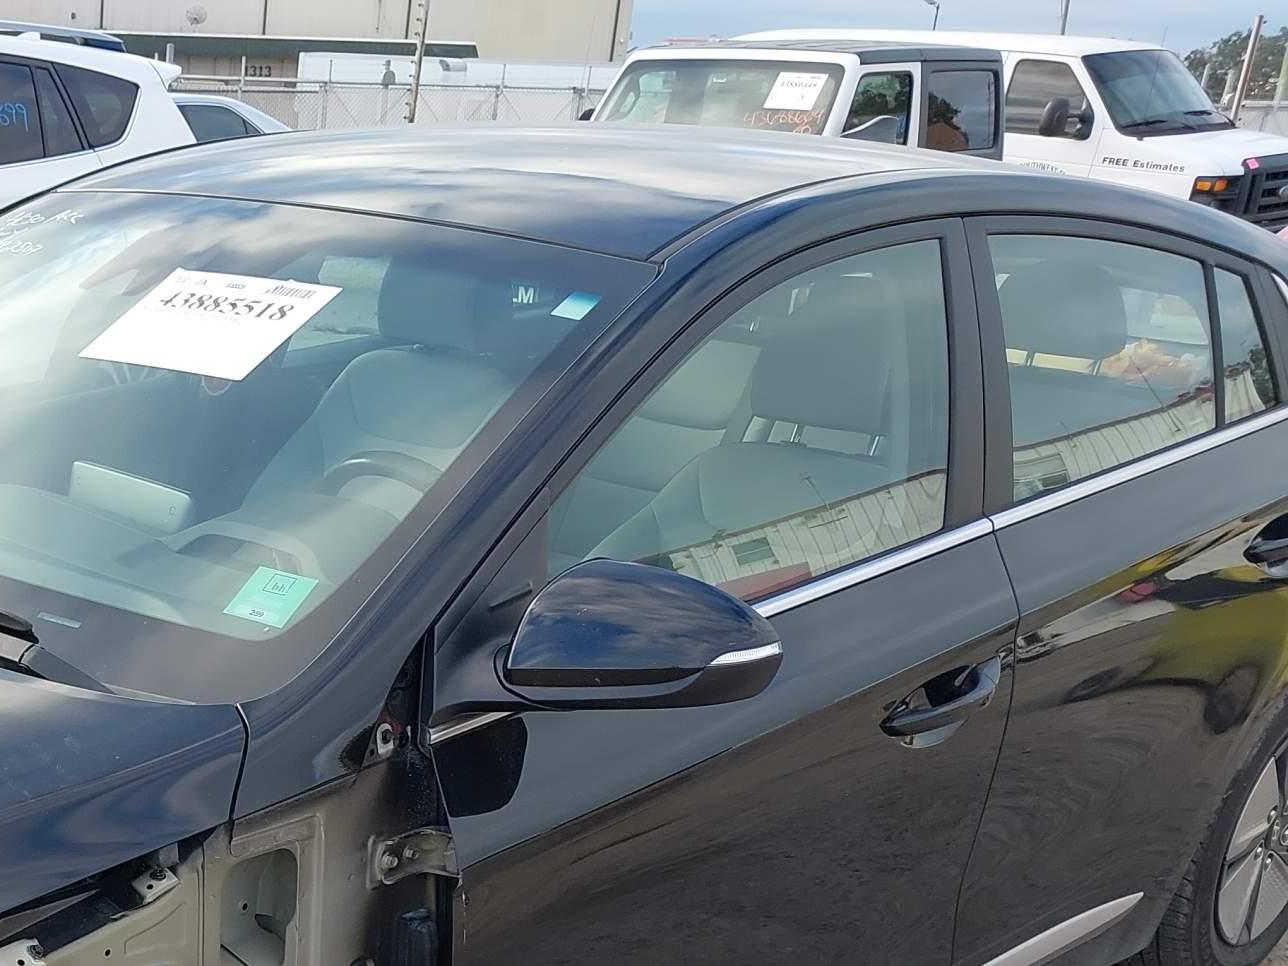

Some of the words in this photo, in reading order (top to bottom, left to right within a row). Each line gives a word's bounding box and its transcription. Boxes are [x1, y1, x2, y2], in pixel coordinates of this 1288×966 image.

[1102, 156, 1129, 167] FREE
[1132, 159, 1185, 173] Estimates
[160, 291, 295, 321] 43885518
